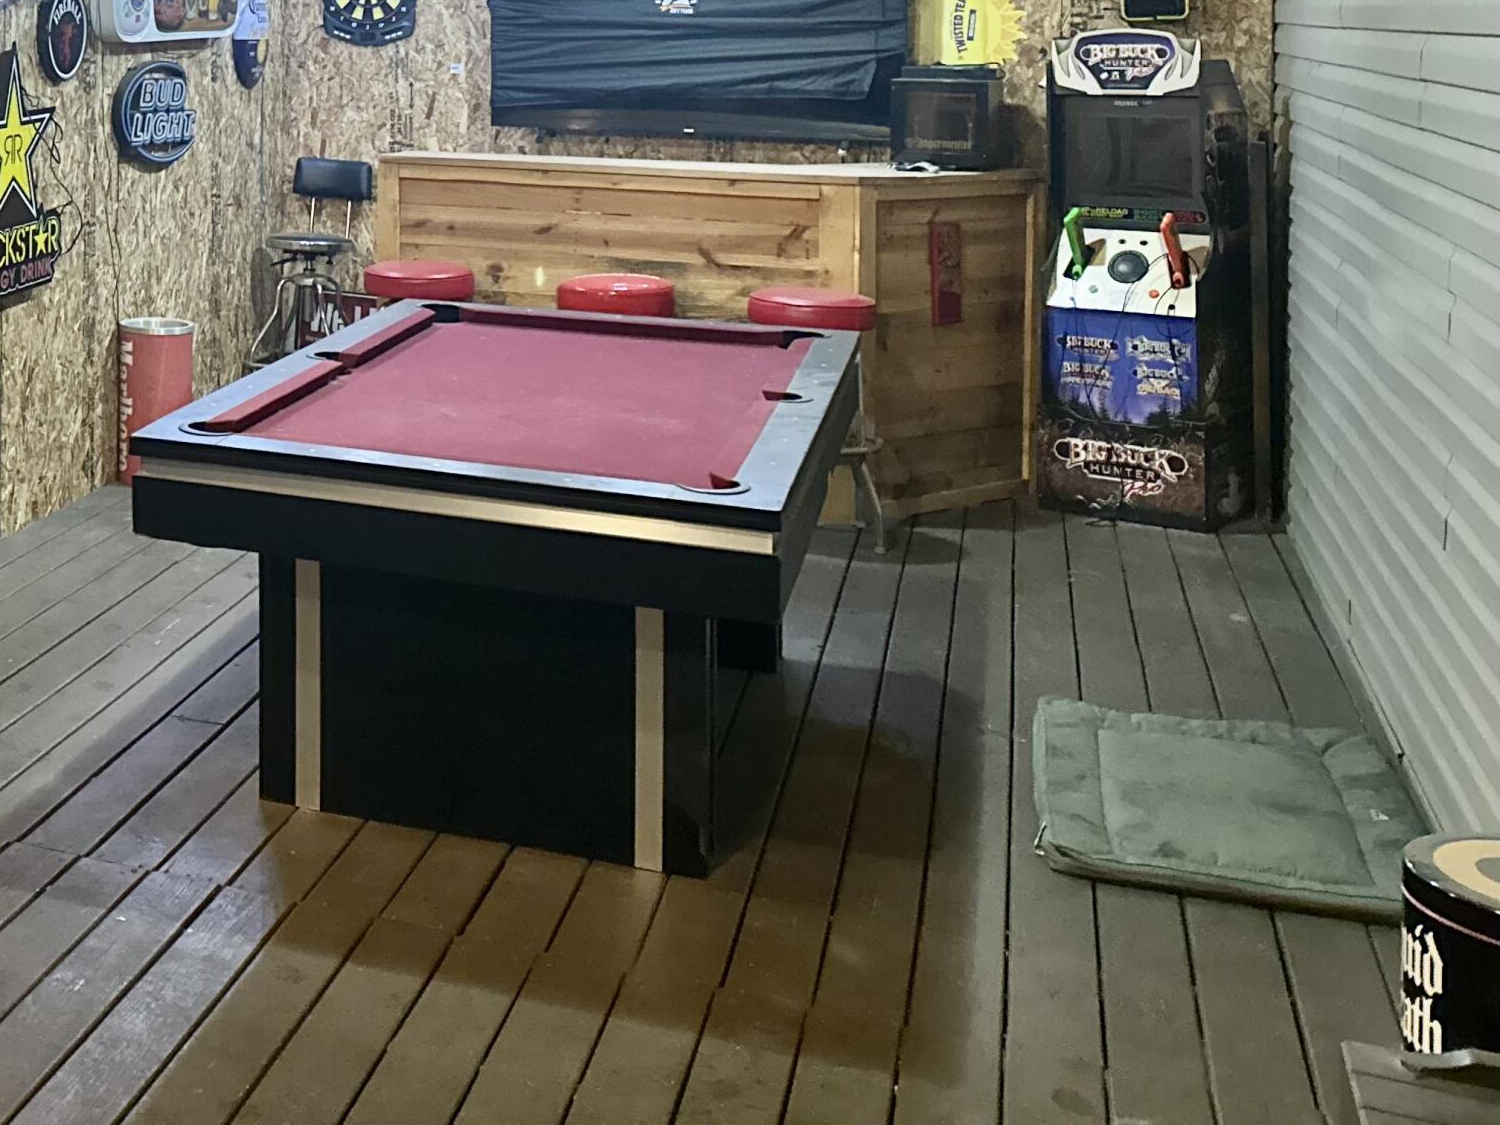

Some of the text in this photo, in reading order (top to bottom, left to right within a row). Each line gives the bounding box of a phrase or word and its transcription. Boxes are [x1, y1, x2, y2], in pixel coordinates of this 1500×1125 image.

[953, 15, 968, 53] TWISTED
[1088, 44, 1163, 64] BIG BUCK
[1104, 59, 1149, 67] HUNTER
[140, 78, 186, 109] BUD
[131, 110, 196, 146] LIGHT
[21, 257, 52, 281] DRINK
[119, 341, 133, 472] Marlboro
[1069, 437, 1177, 479] BIG BUCK
[1090, 464, 1155, 481] HUNTER
[1402, 996, 1443, 1054] ath
